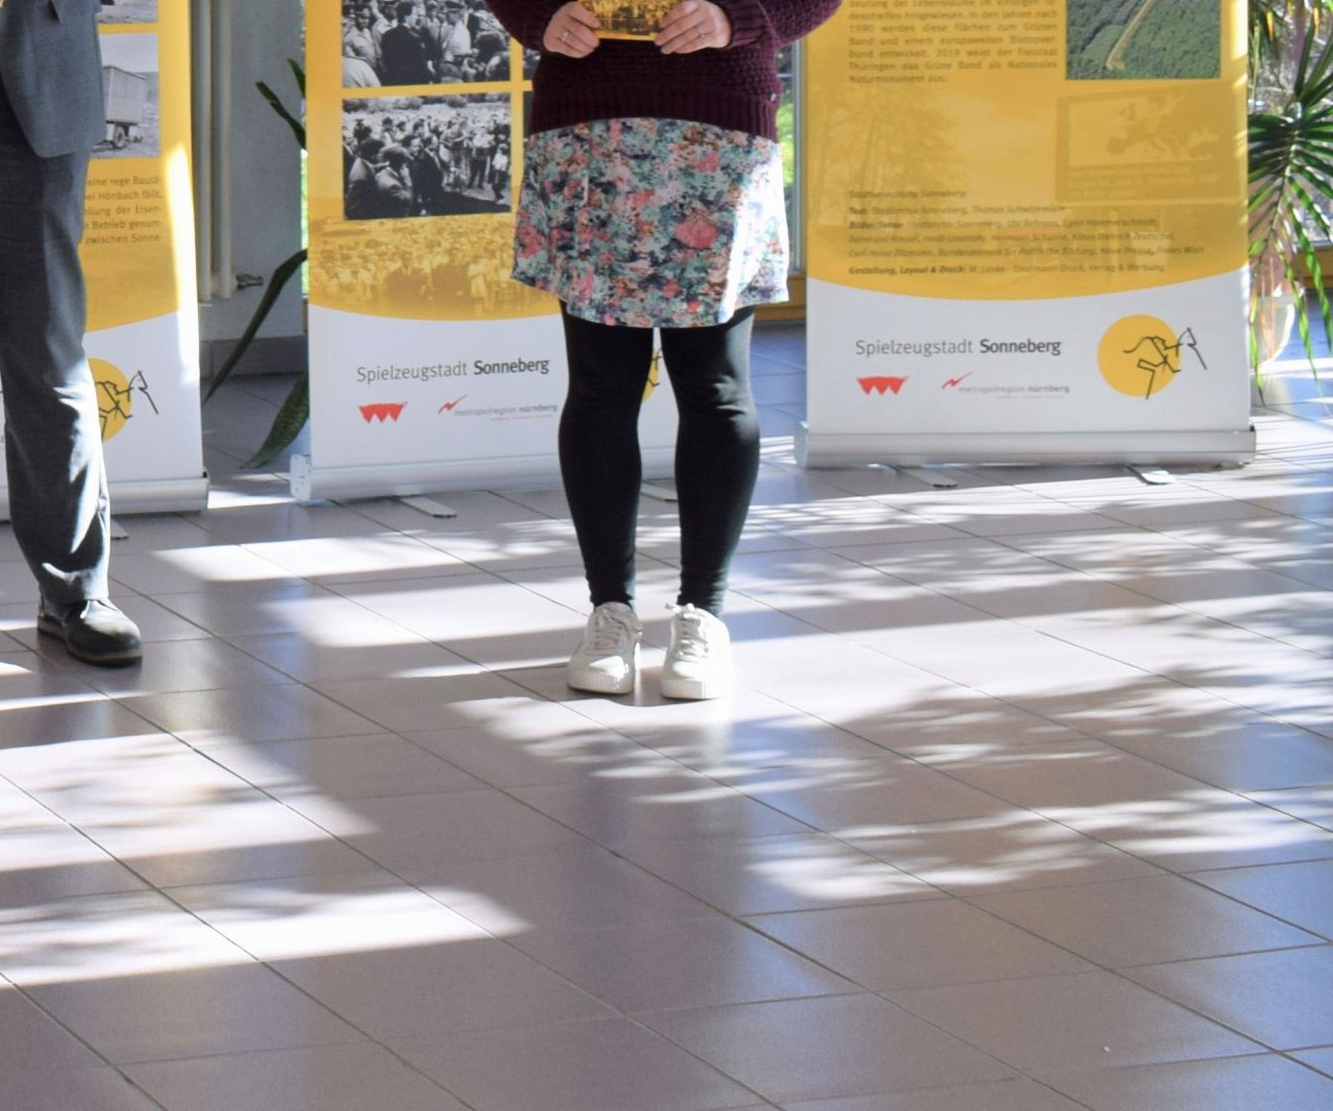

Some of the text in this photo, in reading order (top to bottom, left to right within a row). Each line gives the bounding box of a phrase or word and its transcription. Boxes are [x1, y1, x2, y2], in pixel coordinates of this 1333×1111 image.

[854, 337, 1062, 358] Spielzeugstadt Sonneberg
[356, 356, 551, 385] Spielzeugstadt Sonneberg
